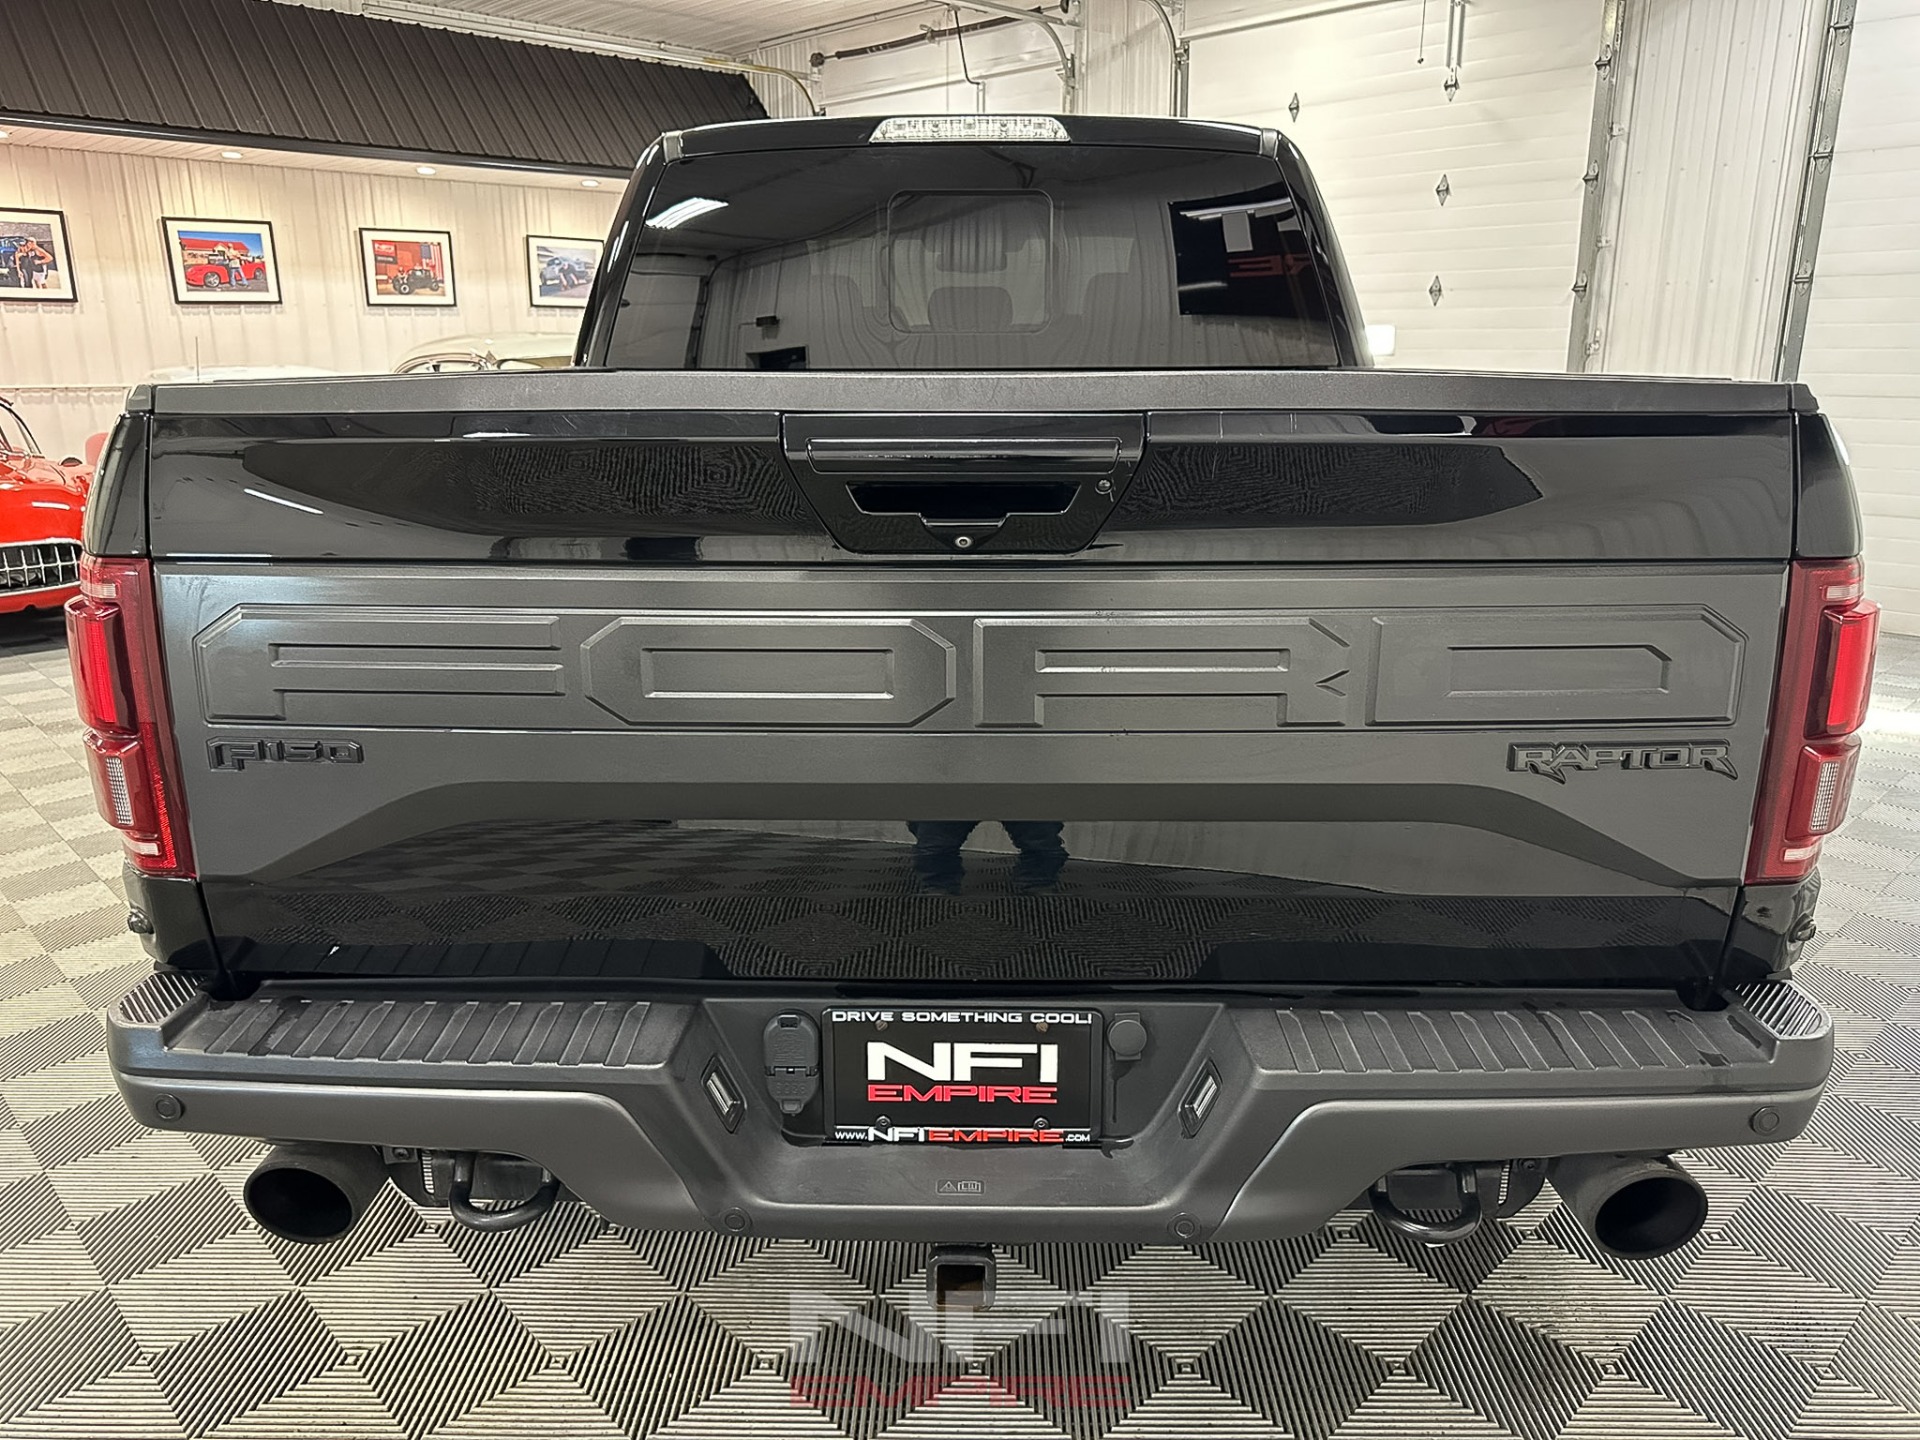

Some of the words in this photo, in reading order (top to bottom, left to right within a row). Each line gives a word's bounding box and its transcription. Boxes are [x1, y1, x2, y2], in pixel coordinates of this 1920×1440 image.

[194, 605, 1746, 729] FORD
[1507, 739, 1738, 785] RAPTOR
[832, 1011, 894, 1022] DRIVE
[901, 1012, 1023, 1023] SOMETHING
[1030, 1012, 1092, 1024] COOL!
[867, 1041, 1058, 1083] NFI
[867, 1084, 1058, 1104] EMPIRE
